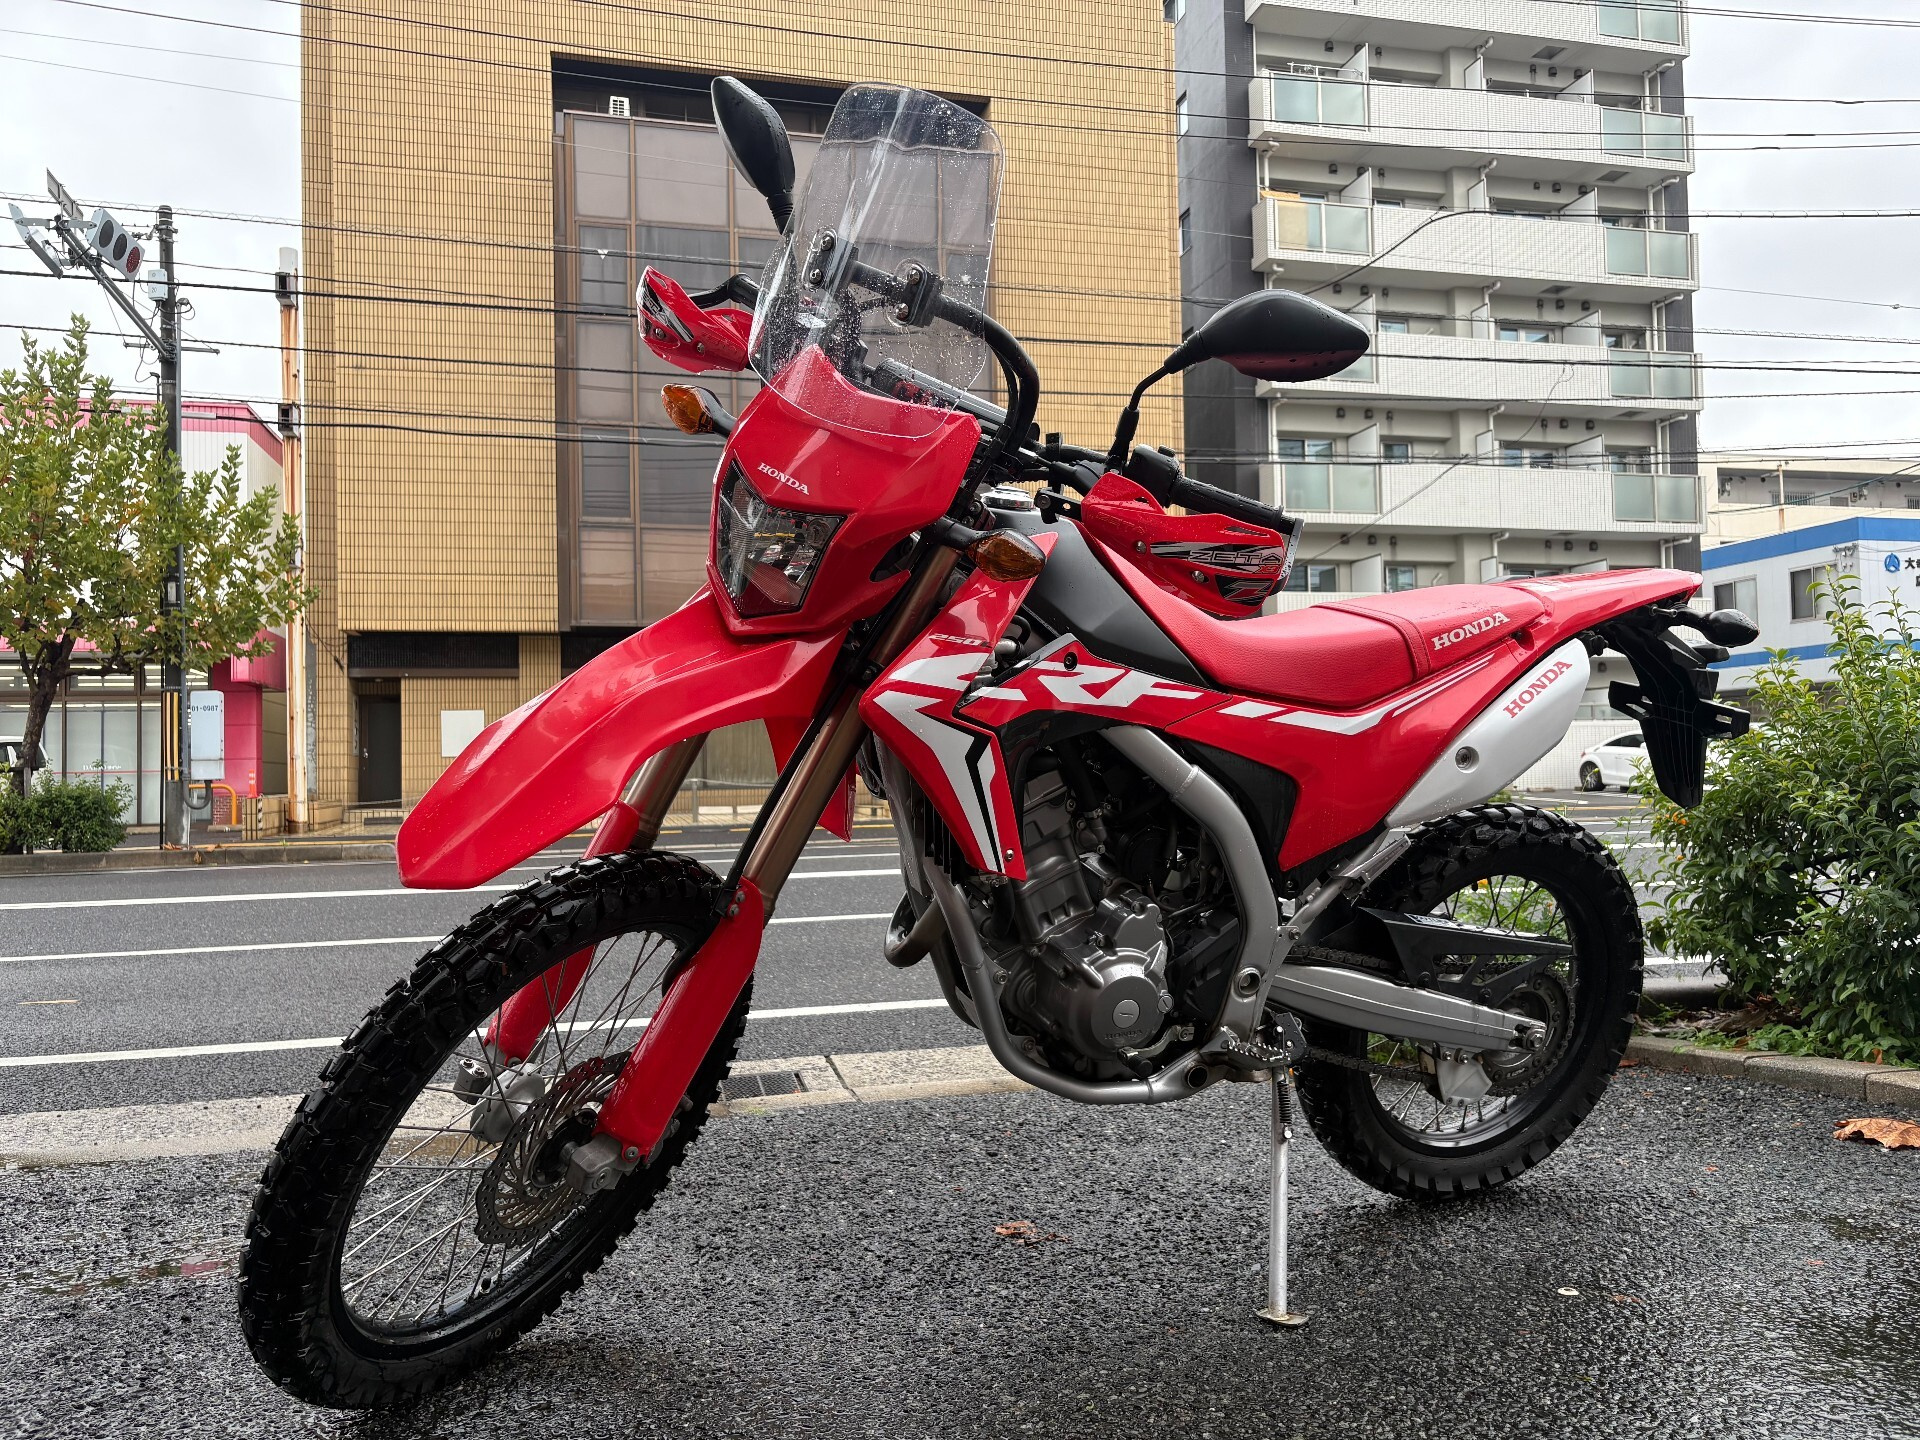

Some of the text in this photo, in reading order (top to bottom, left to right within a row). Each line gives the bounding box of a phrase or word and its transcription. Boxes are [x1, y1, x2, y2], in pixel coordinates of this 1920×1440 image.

[757, 462, 810, 495] HONDA
[1187, 550, 1283, 566] ZETA
[1431, 612, 1511, 651] HONDA
[1503, 660, 1573, 719] HONDA
